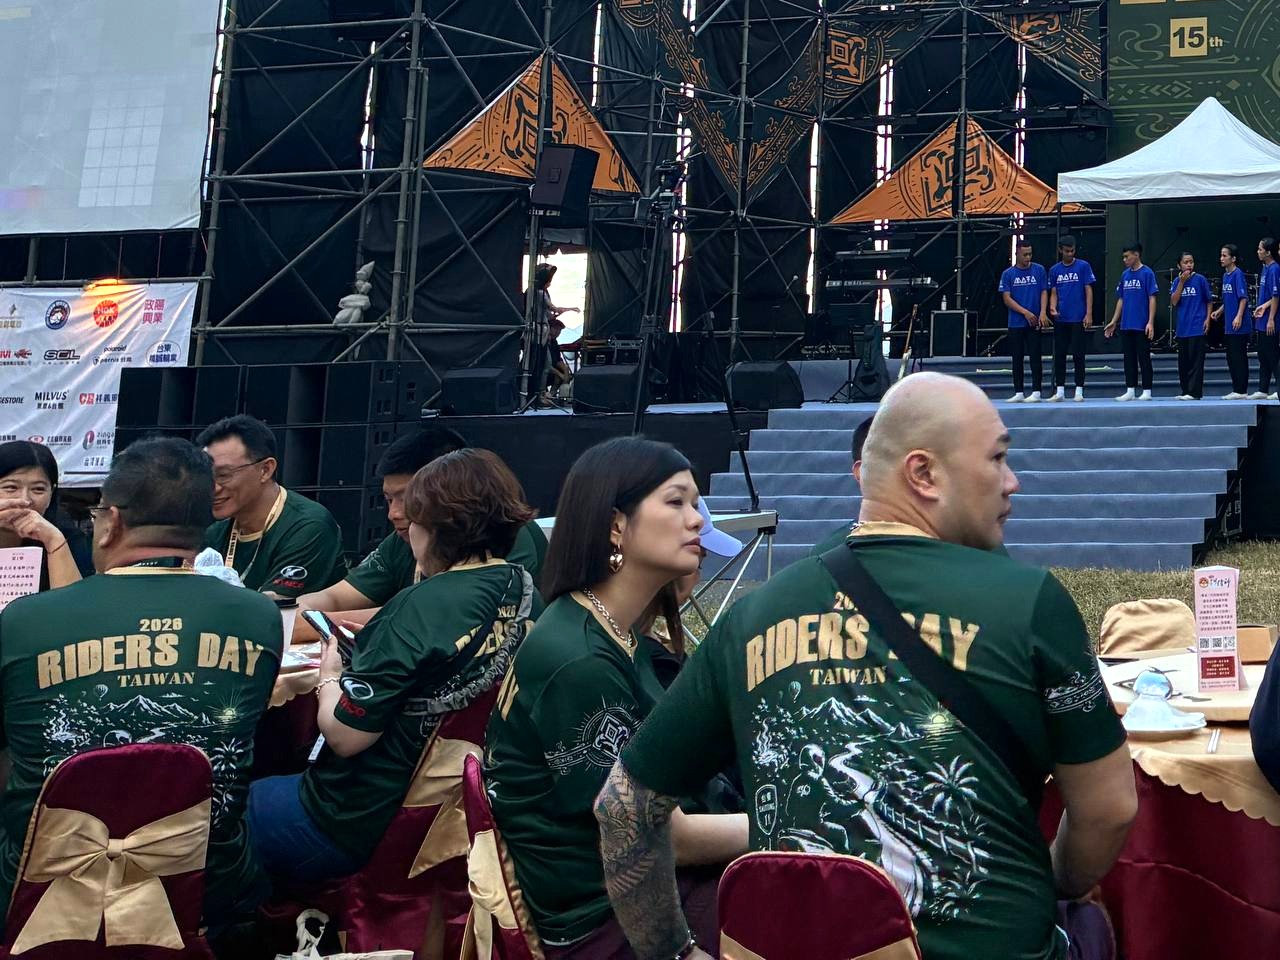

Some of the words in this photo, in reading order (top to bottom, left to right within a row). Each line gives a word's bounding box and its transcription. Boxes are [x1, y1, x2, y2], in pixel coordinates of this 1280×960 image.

[35, 391, 67, 401] MILVUS
[37, 633, 179, 689] RIDERS
[197, 632, 264, 677] DAY
[746, 612, 870, 692] RIDERS
[117, 671, 195, 688] TAIWAN
[810, 665, 887, 685] TAIWAN
